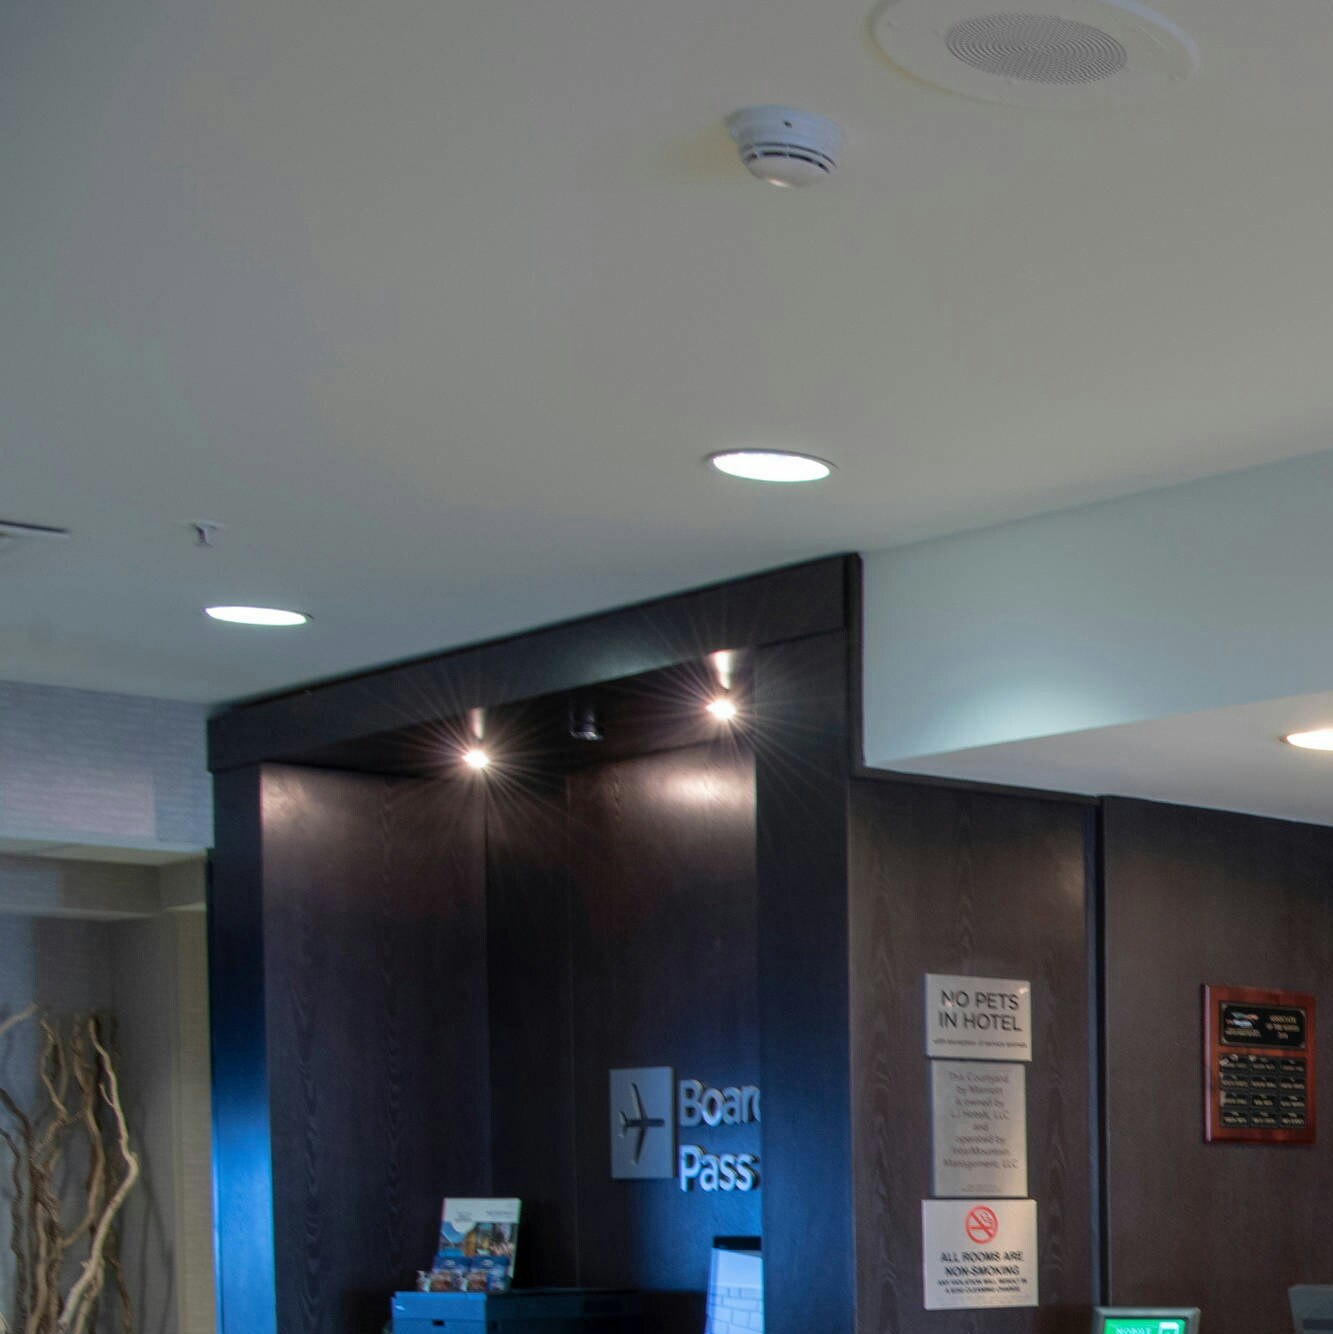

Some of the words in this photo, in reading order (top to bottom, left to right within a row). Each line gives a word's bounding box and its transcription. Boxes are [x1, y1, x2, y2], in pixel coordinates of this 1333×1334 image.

[940, 989, 970, 1009] NO
[976, 991, 1019, 1011] PETS
[938, 1011, 958, 1030] IN
[964, 1012, 1024, 1032] HOTEL
[679, 1144, 758, 1193] Pass
[940, 1250, 960, 1263] ALL
[961, 1250, 1001, 1263] ROOMS
[1003, 1250, 1024, 1262] ARE
[944, 1265, 1020, 1277] NON-SMOKING
